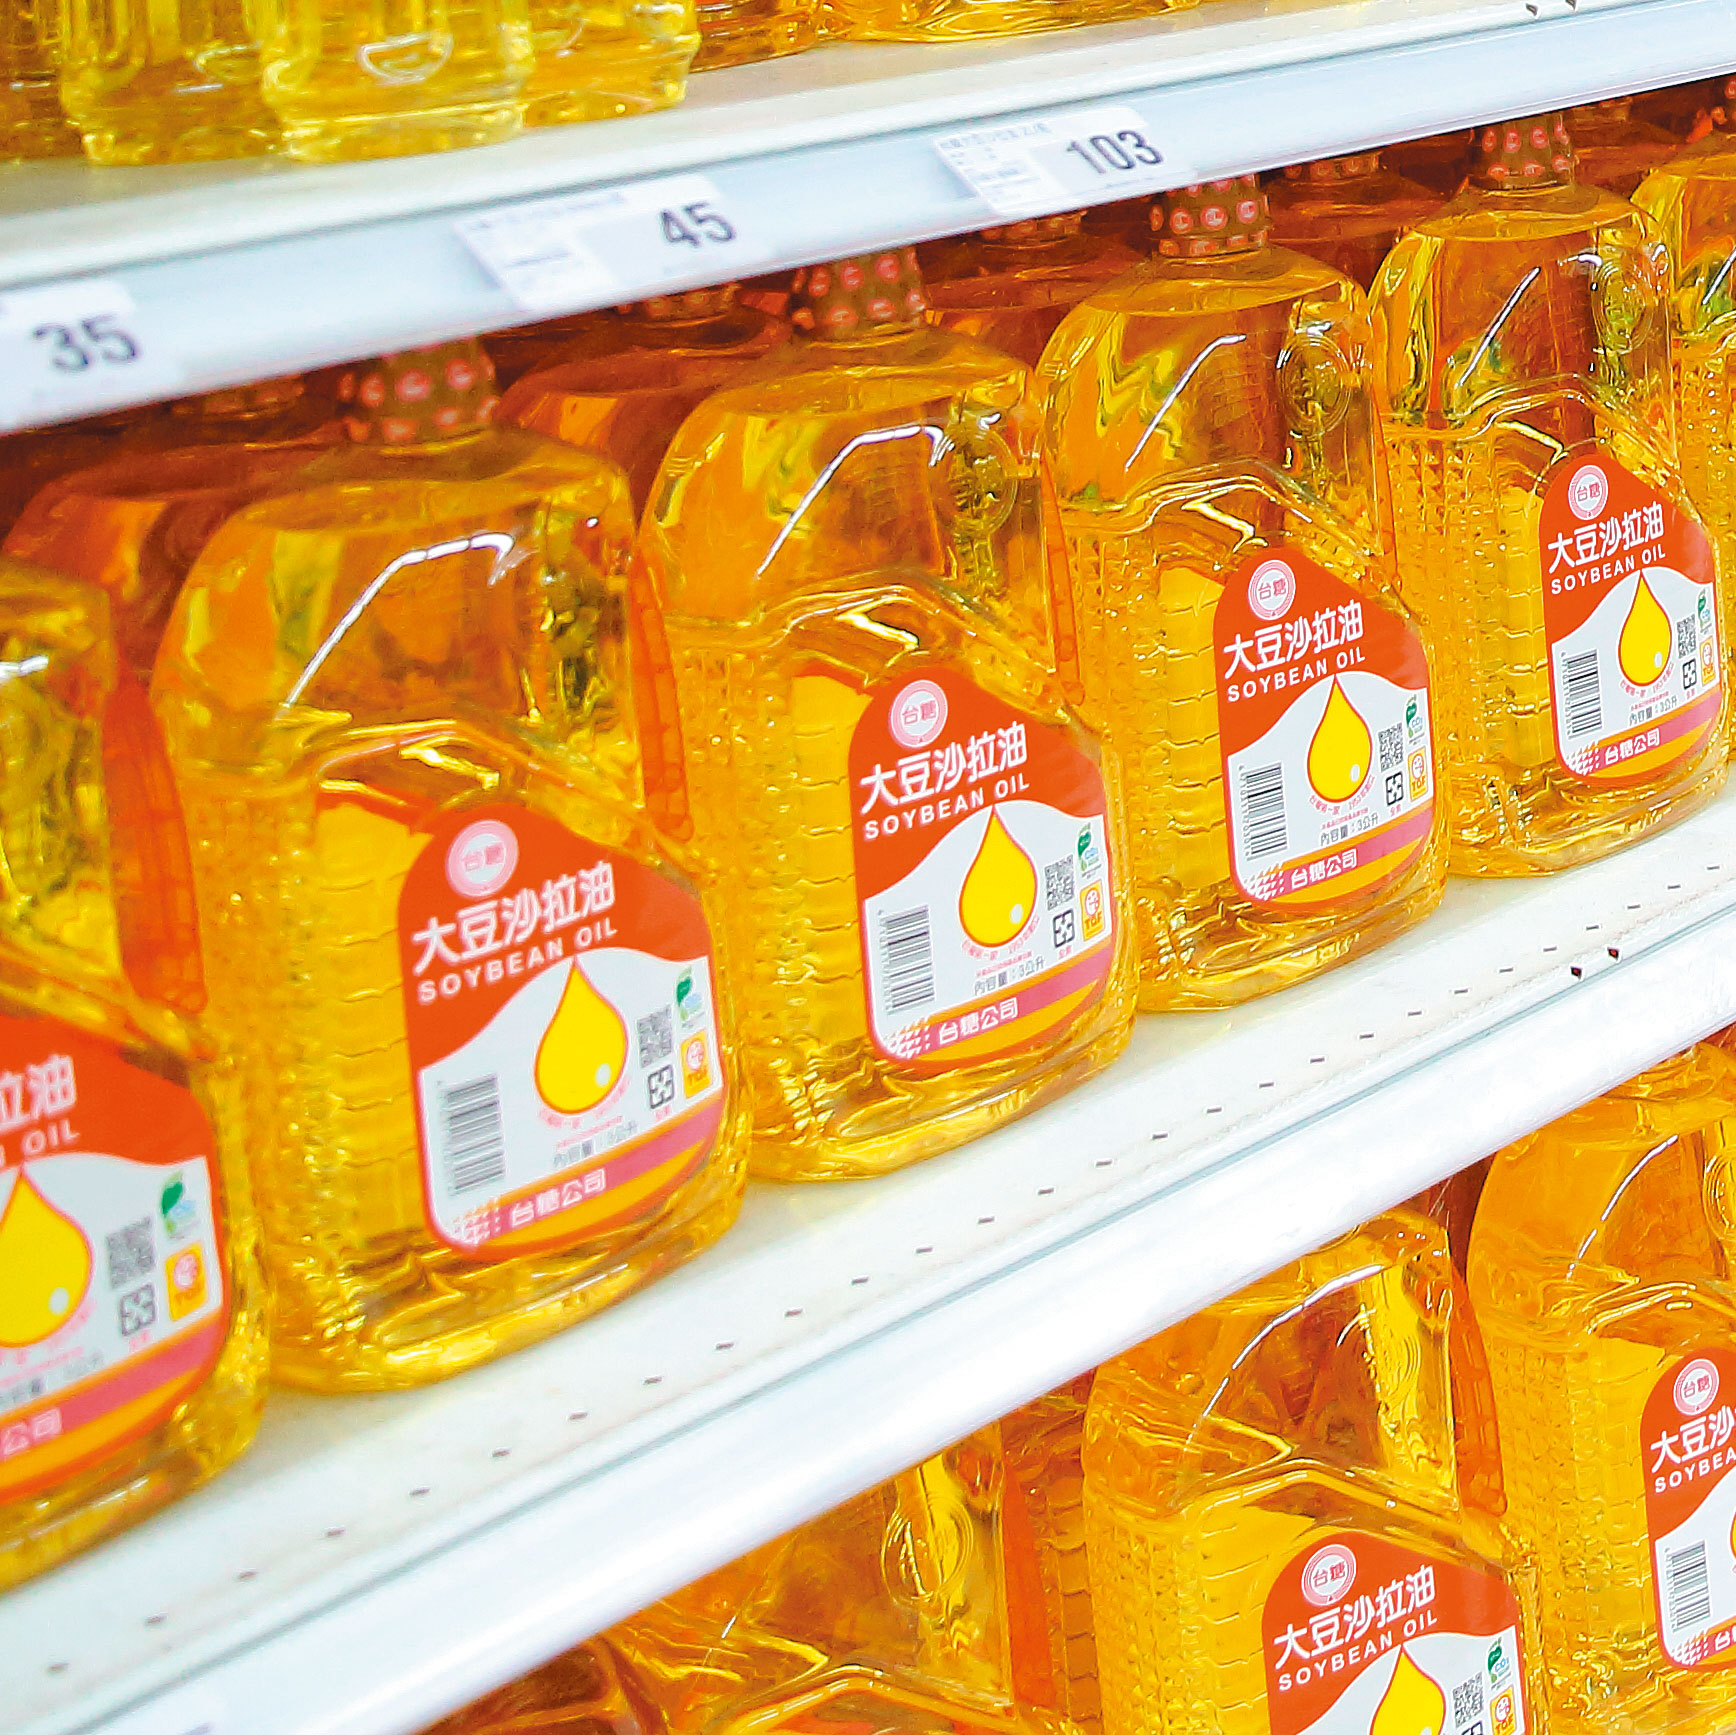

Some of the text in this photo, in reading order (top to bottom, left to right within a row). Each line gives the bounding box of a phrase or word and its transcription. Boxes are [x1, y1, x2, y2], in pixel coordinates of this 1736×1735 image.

[1066, 129, 1164, 175] 103
[660, 200, 738, 249] 45
[33, 313, 139, 374] 35
[1547, 501, 1665, 575] 大豆沙拉油
[1257, 576, 1289, 601] 台糖
[1550, 542, 1667, 596] SOYBEAN OIL
[1223, 599, 1365, 681] 大豆沙拉油
[1226, 645, 1366, 703] SOYBEAN OIL
[900, 699, 938, 727] 台糖
[859, 719, 1029, 815] 大豆沙拉油
[1604, 727, 1661, 767] 台糖公司
[863, 771, 1031, 841] SOYBEAN OIL
[1290, 847, 1359, 892] 台糖公司
[411, 860, 617, 977] 大豆沙拉油
[417, 915, 619, 1005] SOYBEAN OIL
[937, 996, 1021, 1047] 台糖公司
[22, 1124, 80, 1157] OIL
[1273, 1564, 1436, 1671] 大豆沙拉油
[1278, 1609, 1438, 1692] SOYBEAN OIL
